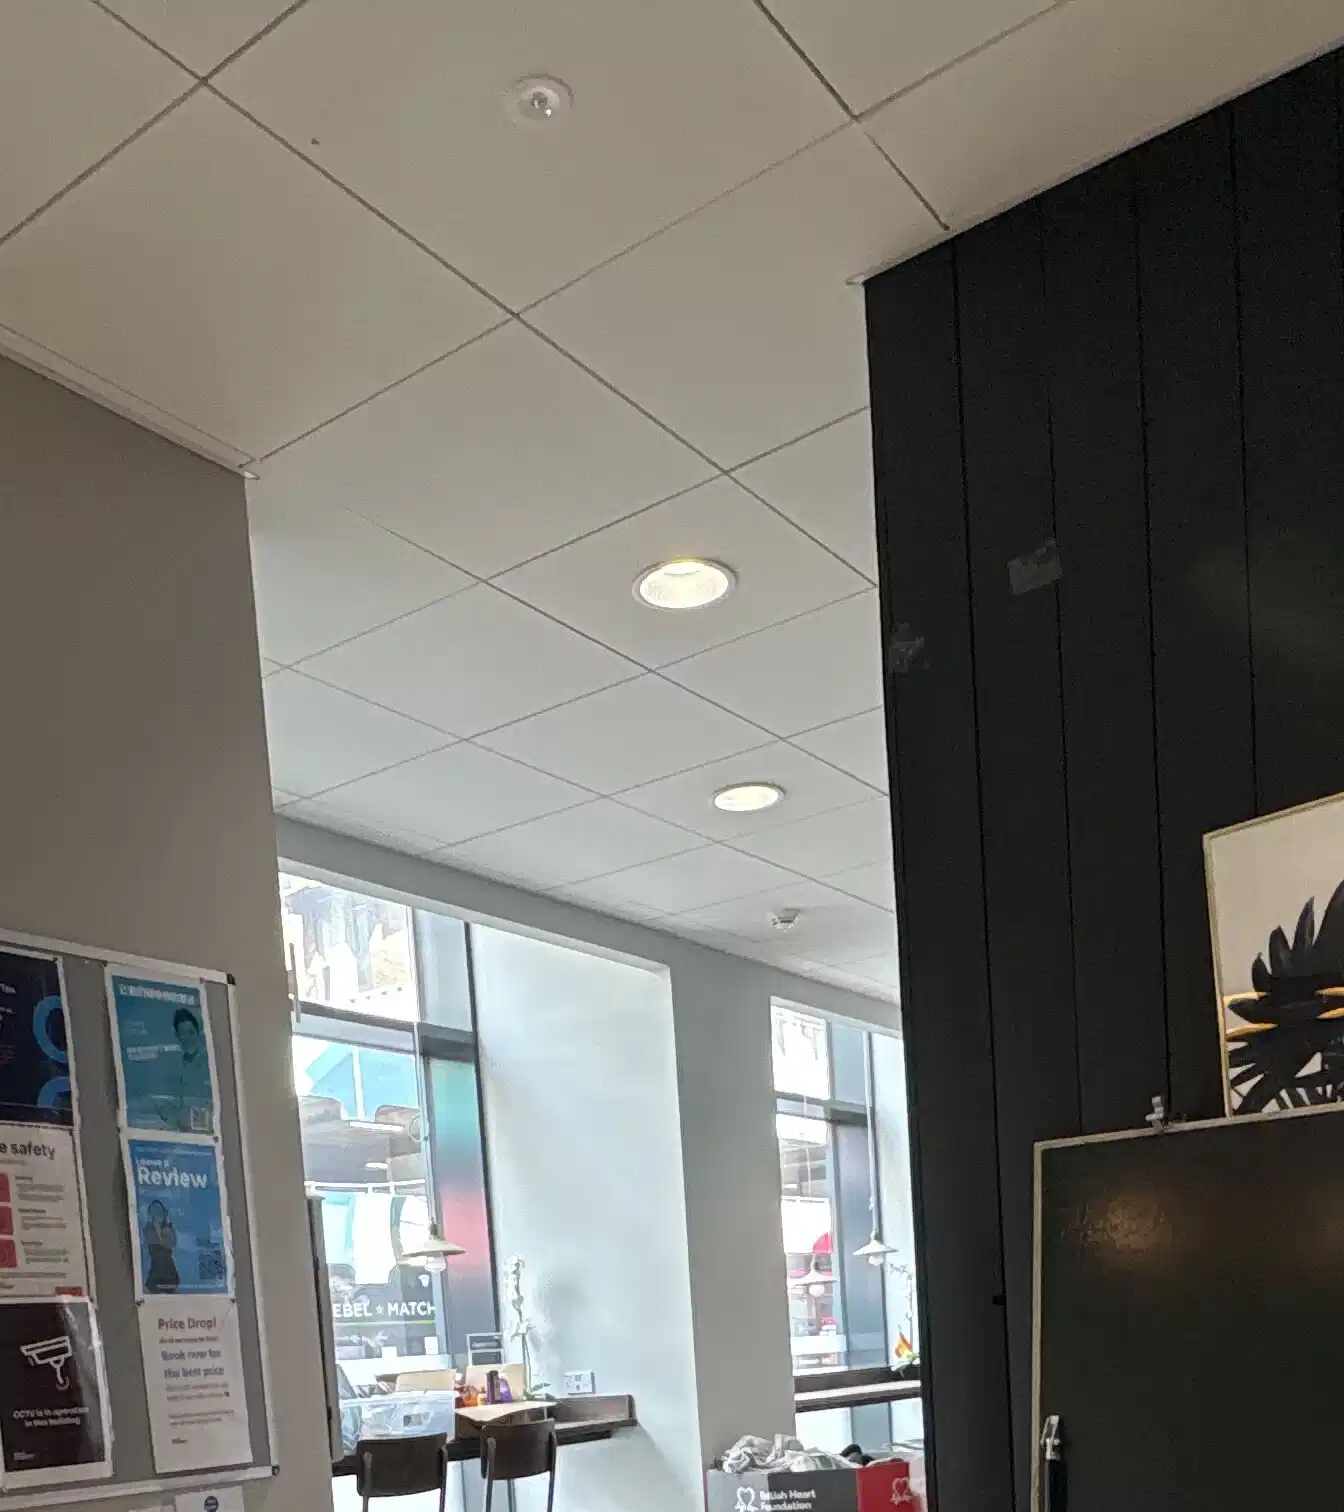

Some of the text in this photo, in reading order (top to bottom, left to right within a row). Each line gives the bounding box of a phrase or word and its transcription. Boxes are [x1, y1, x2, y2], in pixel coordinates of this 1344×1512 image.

[10, 1141, 55, 1160] safety
[137, 1166, 208, 1188] Review
[157, 1316, 217, 1331] Price Drop!
[789, 1489, 817, 1500] Heart
[760, 1501, 813, 1512] Foundation
